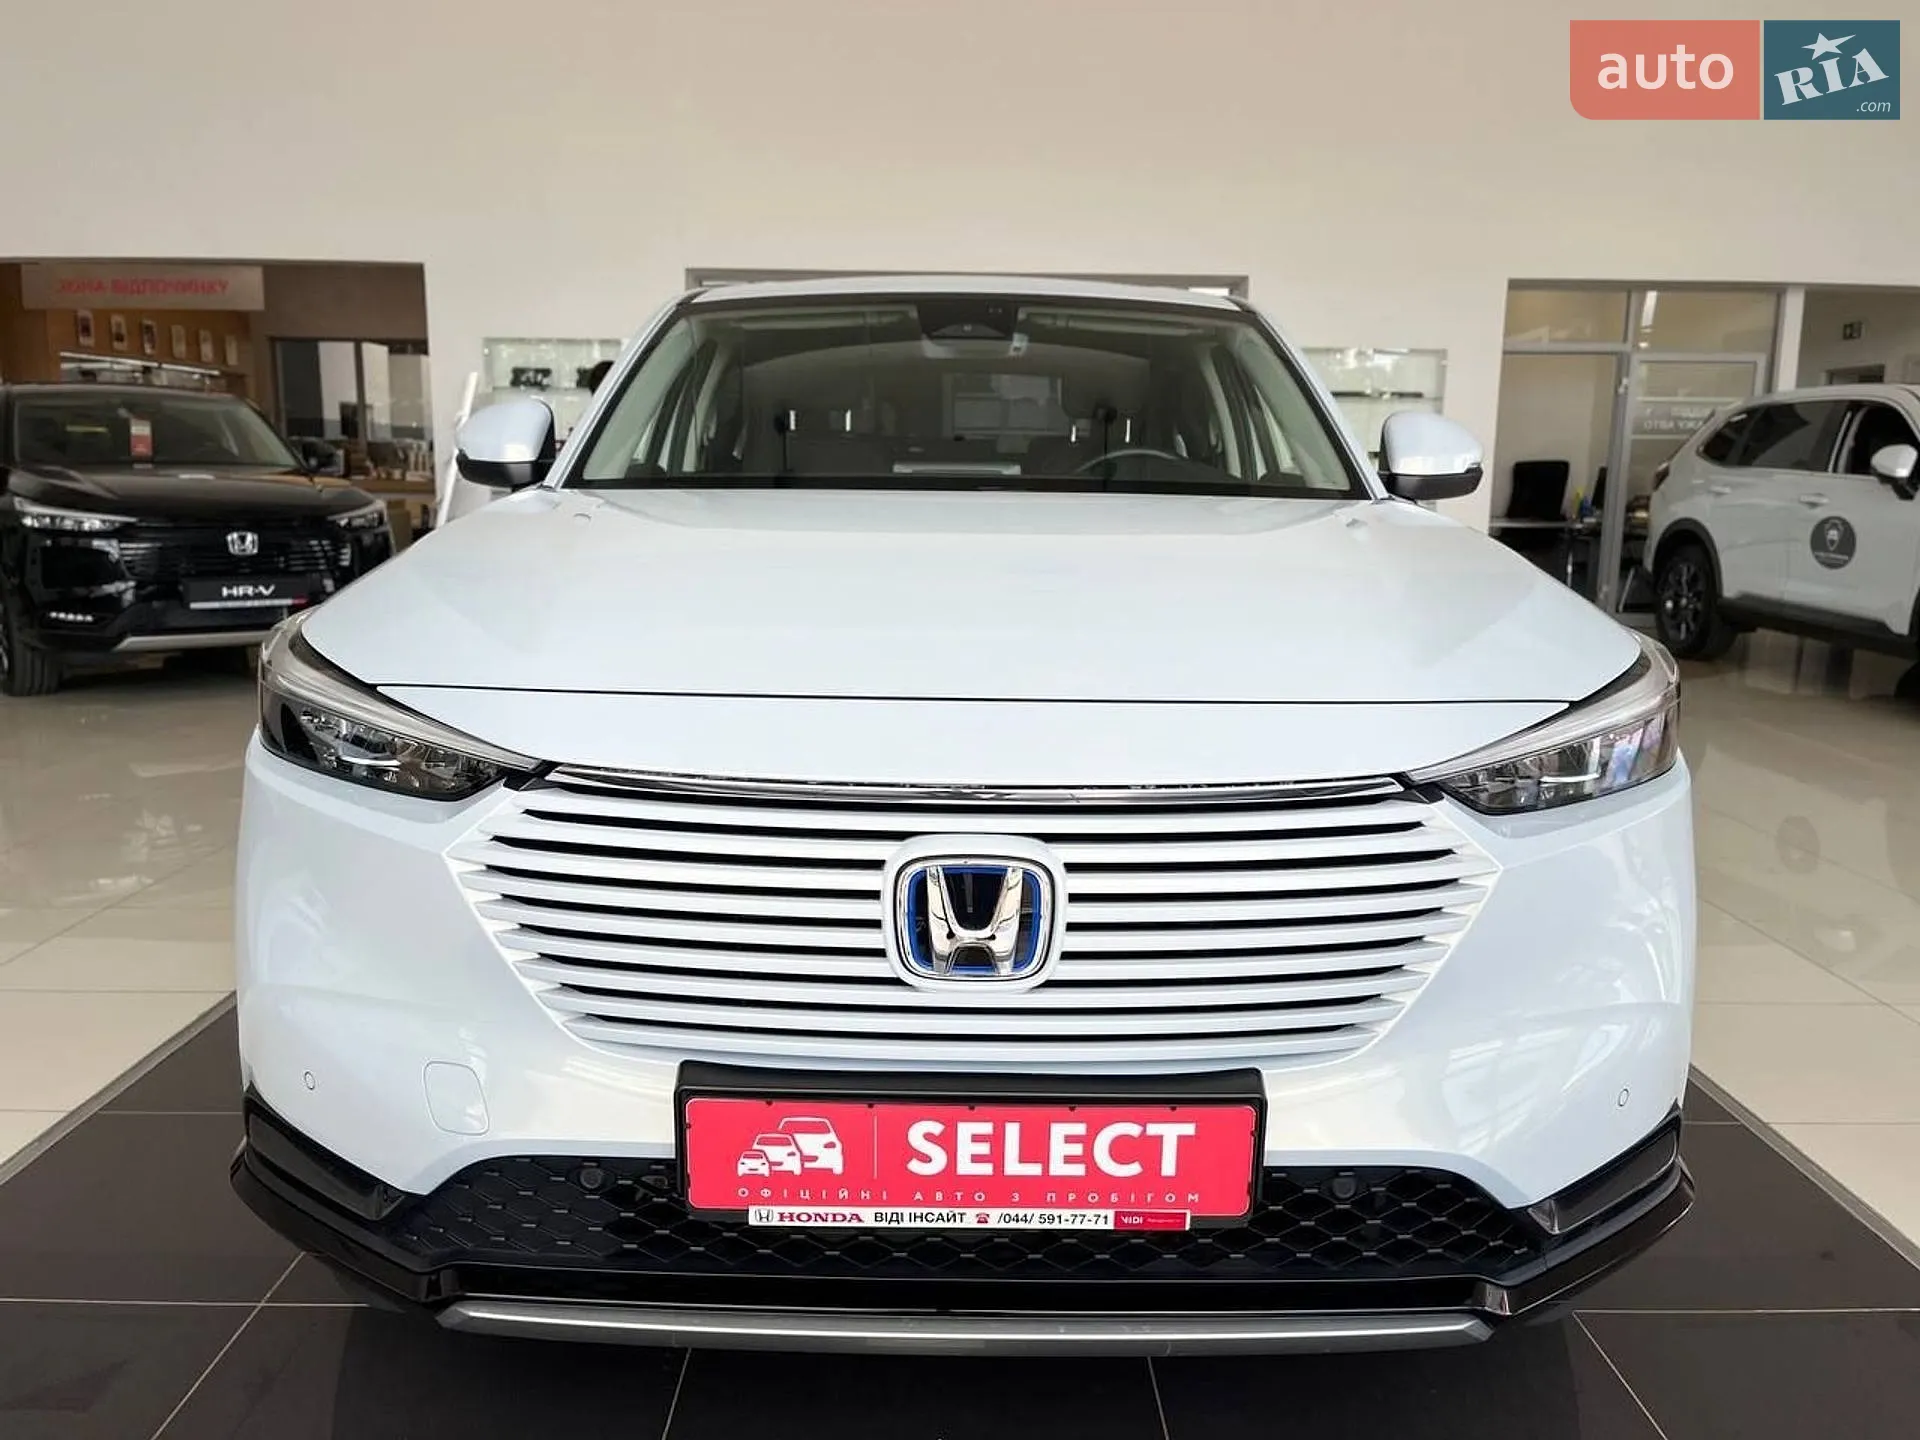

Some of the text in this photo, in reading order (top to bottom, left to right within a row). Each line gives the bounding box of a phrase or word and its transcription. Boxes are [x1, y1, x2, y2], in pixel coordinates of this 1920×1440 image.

[906, 1120, 1197, 1177] SELECT
[914, 1190, 986, 1202] АВТО
[1046, 1191, 1200, 1204] ПРОБІГОМ
[778, 1212, 863, 1224] HONDA
[873, 1212, 906, 1227] ВІДІ
[908, 1210, 967, 1225] ІНСАЙТ
[997, 1211, 1035, 1225] /044/
[1038, 1212, 1110, 1225] 591-77-71
